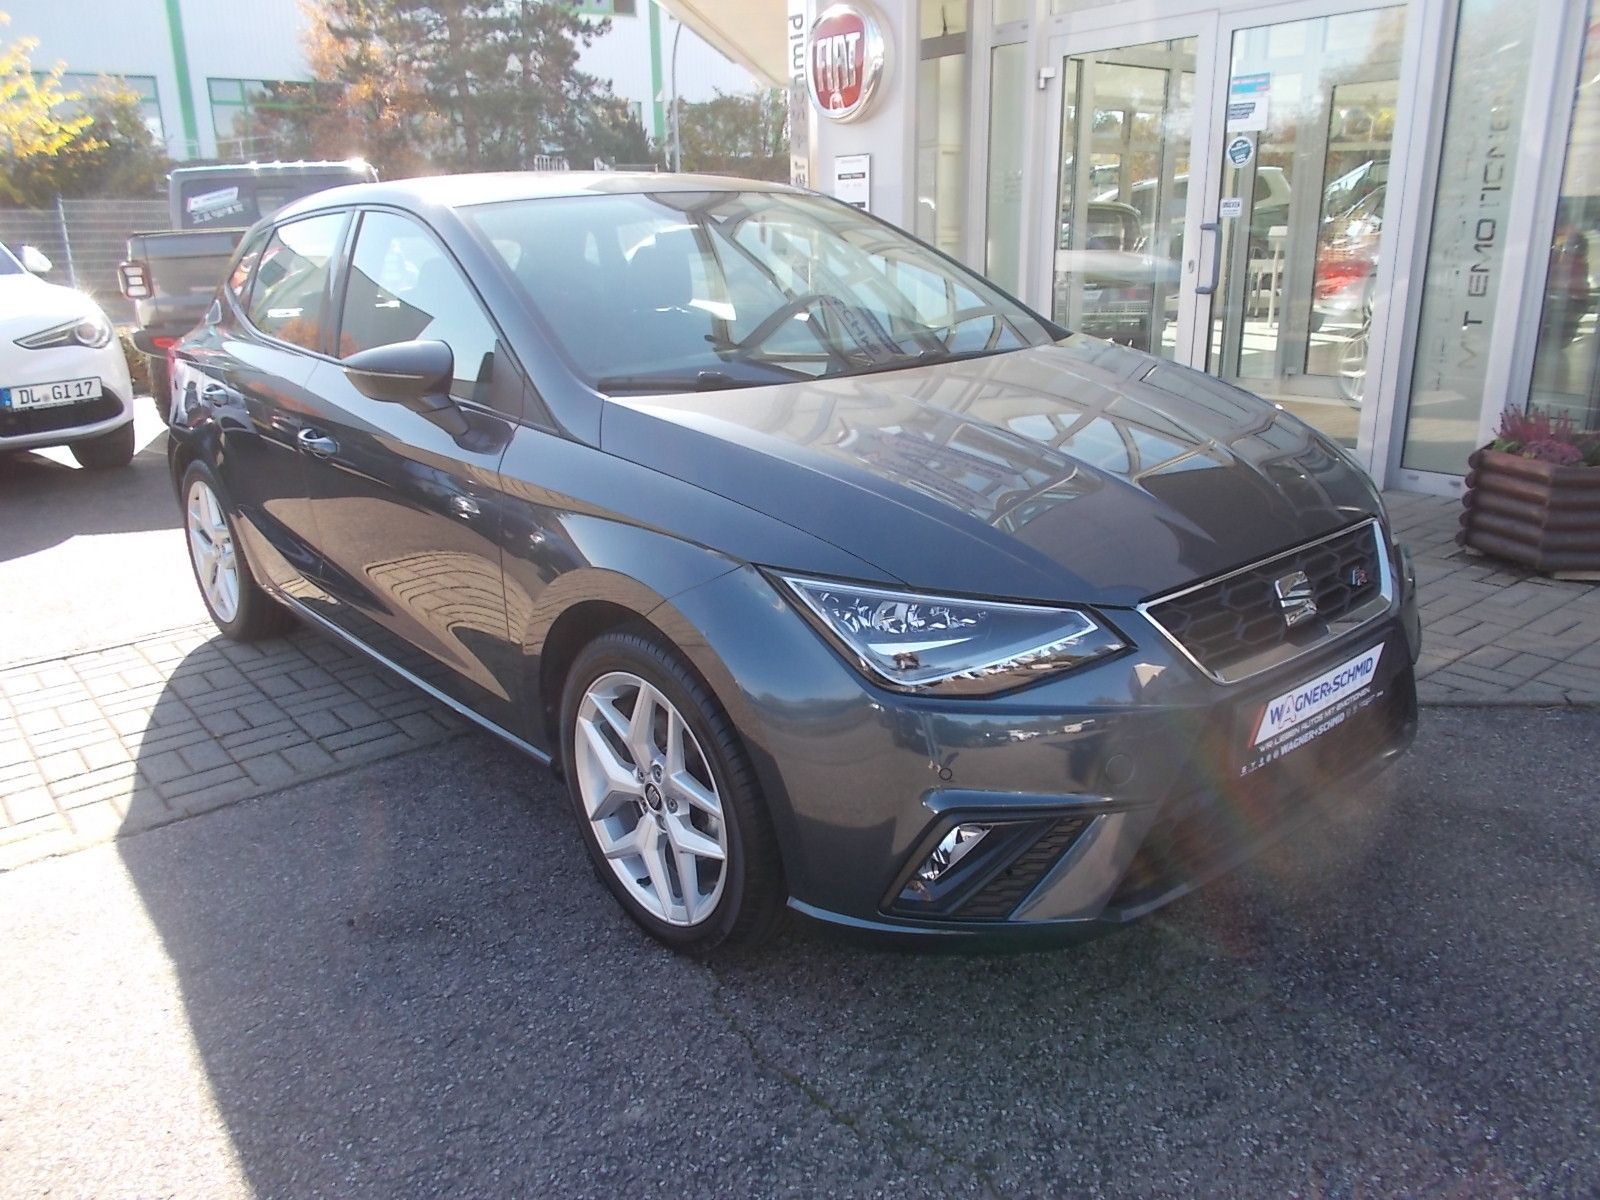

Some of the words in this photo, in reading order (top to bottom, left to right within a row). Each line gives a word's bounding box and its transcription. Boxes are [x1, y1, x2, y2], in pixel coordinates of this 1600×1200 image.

[815, 31, 860, 93] FIAT
[19, 389, 41, 405] DL
[52, 384, 72, 400] GI
[75, 381, 93, 397] 17
[1269, 657, 1373, 726] WAGNER+SCHMID
